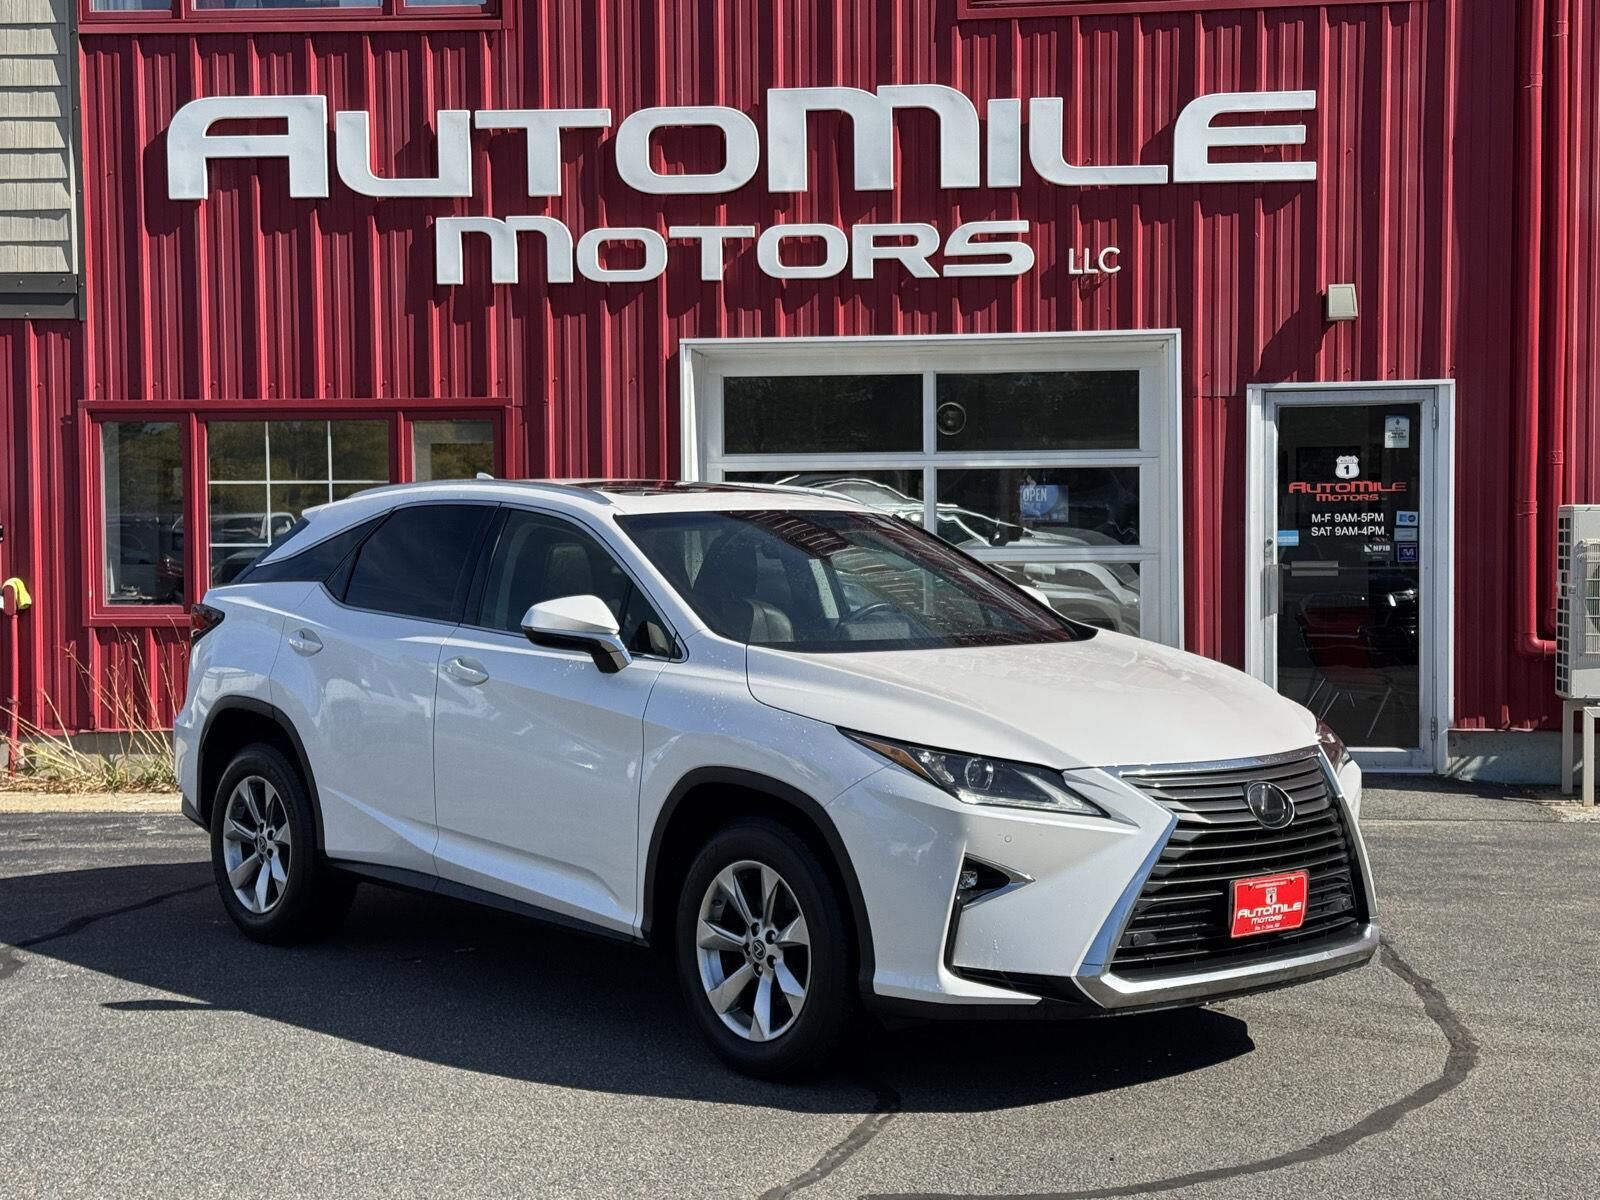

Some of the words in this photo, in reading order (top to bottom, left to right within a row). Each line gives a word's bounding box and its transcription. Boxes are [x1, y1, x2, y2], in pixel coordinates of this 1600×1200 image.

[167, 83, 1317, 201] AUTOMILE
[435, 215, 1035, 286] MOTORS
[1068, 246, 1122, 276] LLC
[1344, 465, 1350, 475] 1
[1288, 481, 1407, 493] AUTOMILE
[1023, 488, 1048, 502] OPEN
[1315, 493, 1379, 502] MOTORS
[1311, 513, 1332, 523] M-F
[1334, 512, 1384, 523] 9AM-5PM
[1311, 526, 1333, 537] SAT
[1335, 526, 1385, 536] 9AM-4PM
[1237, 902, 1302, 919] AUTOMILE
[1252, 914, 1283, 925] MOTORS
